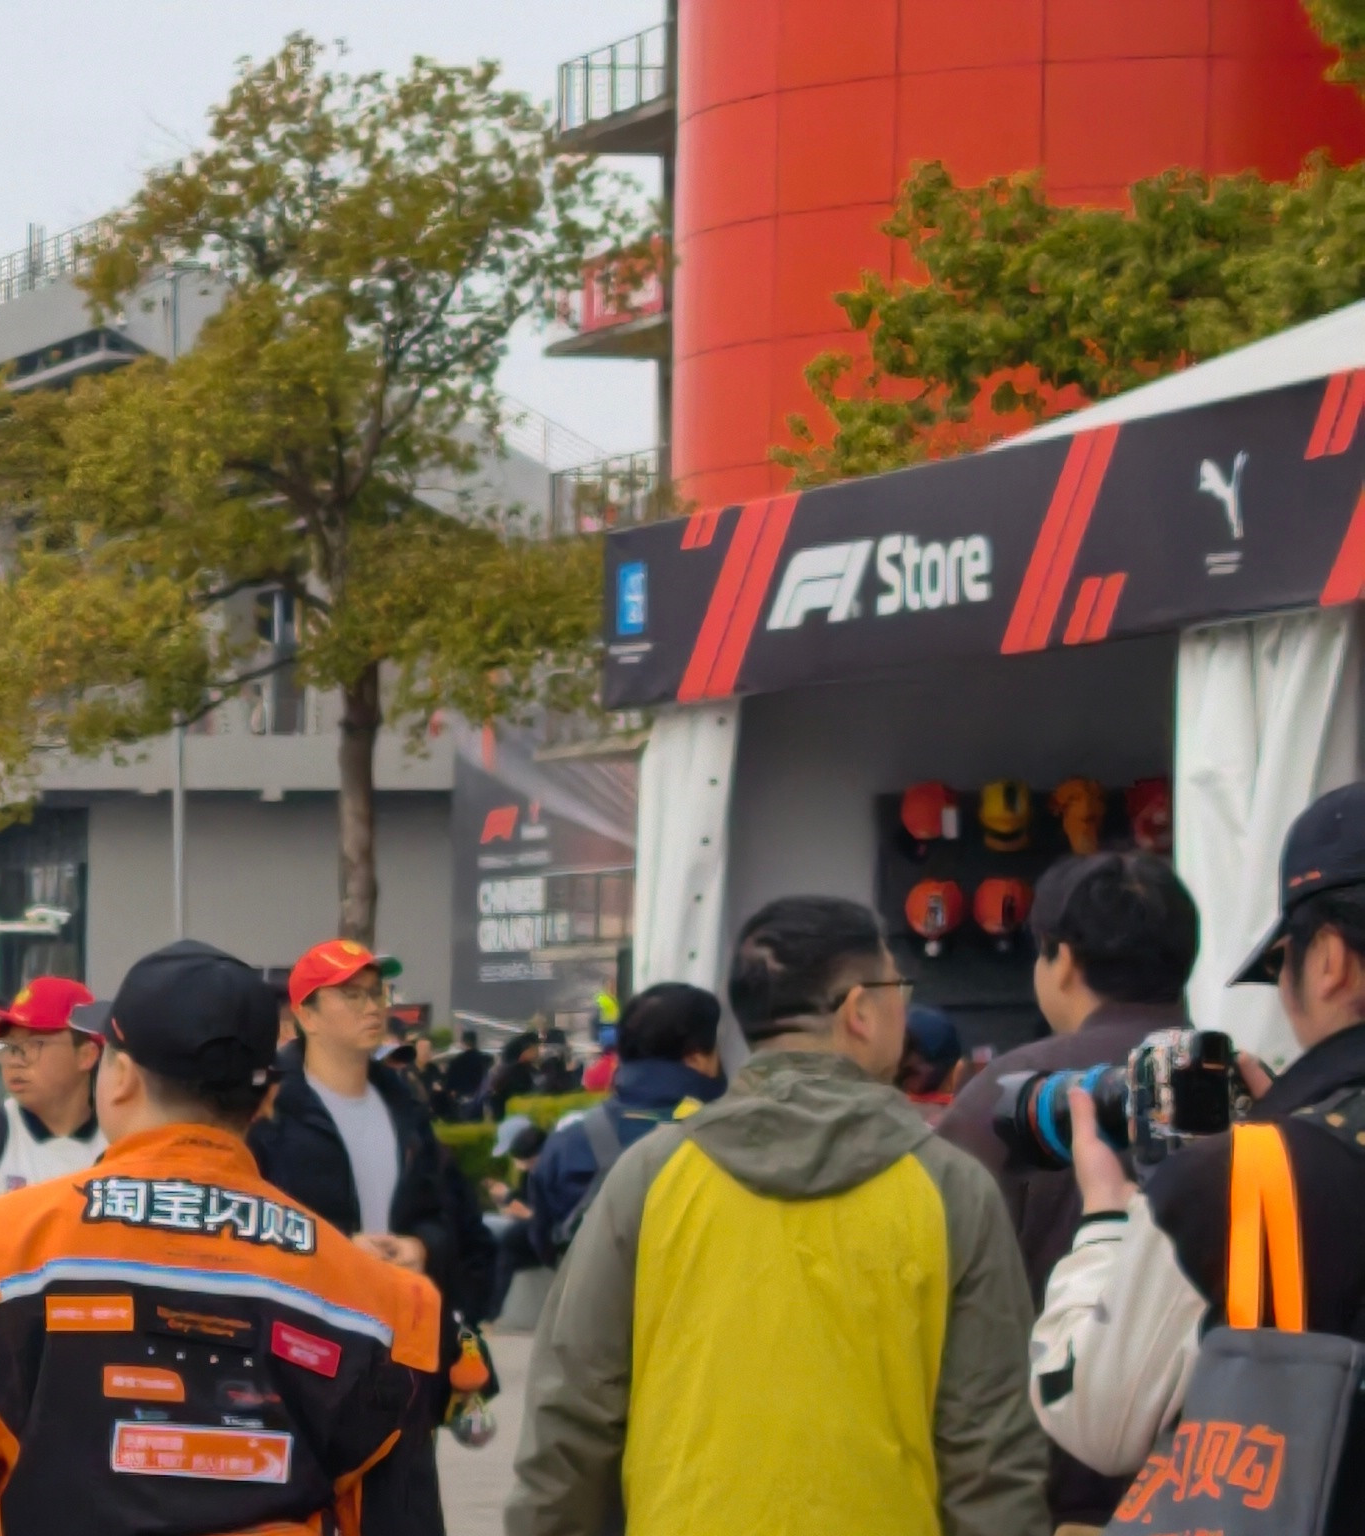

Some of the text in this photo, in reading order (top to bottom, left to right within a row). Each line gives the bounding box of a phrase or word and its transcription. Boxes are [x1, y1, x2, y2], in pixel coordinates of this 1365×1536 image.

[876, 533, 995, 616] Store
[90, 1178, 313, 1251] 淘宝闪购
